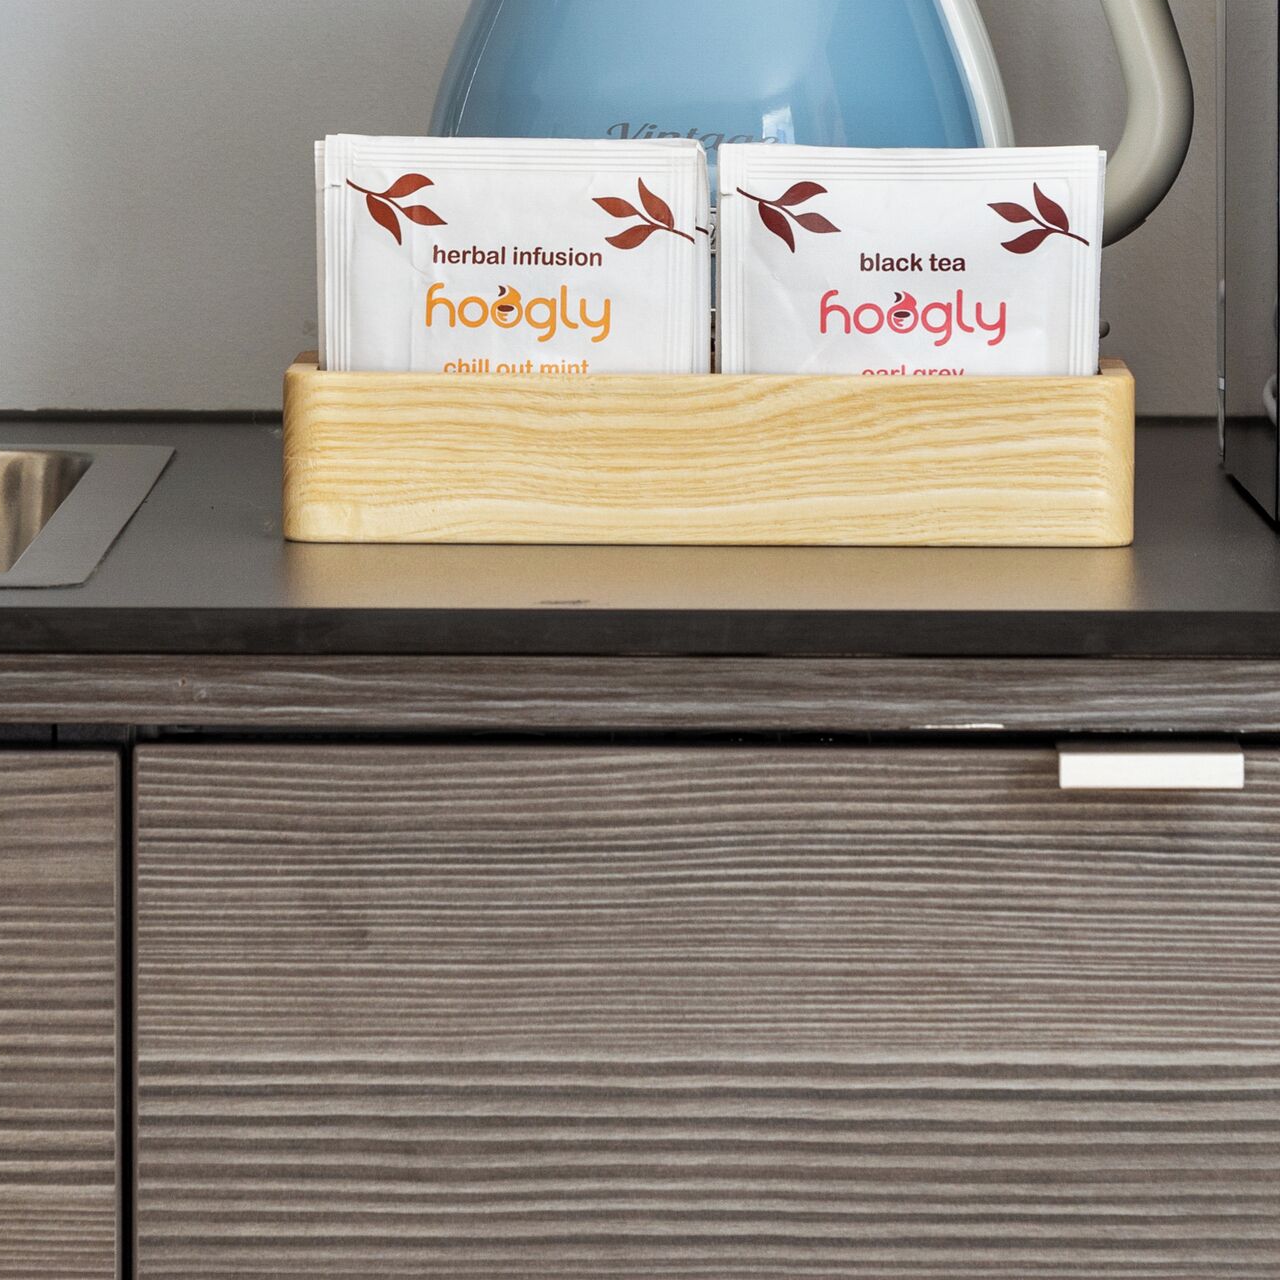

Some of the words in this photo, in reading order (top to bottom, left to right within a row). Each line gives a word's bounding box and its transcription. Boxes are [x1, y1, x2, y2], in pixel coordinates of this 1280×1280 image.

[433, 245, 505, 265] herbal
[513, 247, 602, 266] infusion
[860, 253, 923, 272] black
[929, 253, 966, 272] tea
[426, 282, 611, 343] hoogly
[820, 289, 1006, 347] hoogly
[444, 358, 490, 373] chill
[496, 359, 533, 374] out
[540, 359, 589, 374] mint
